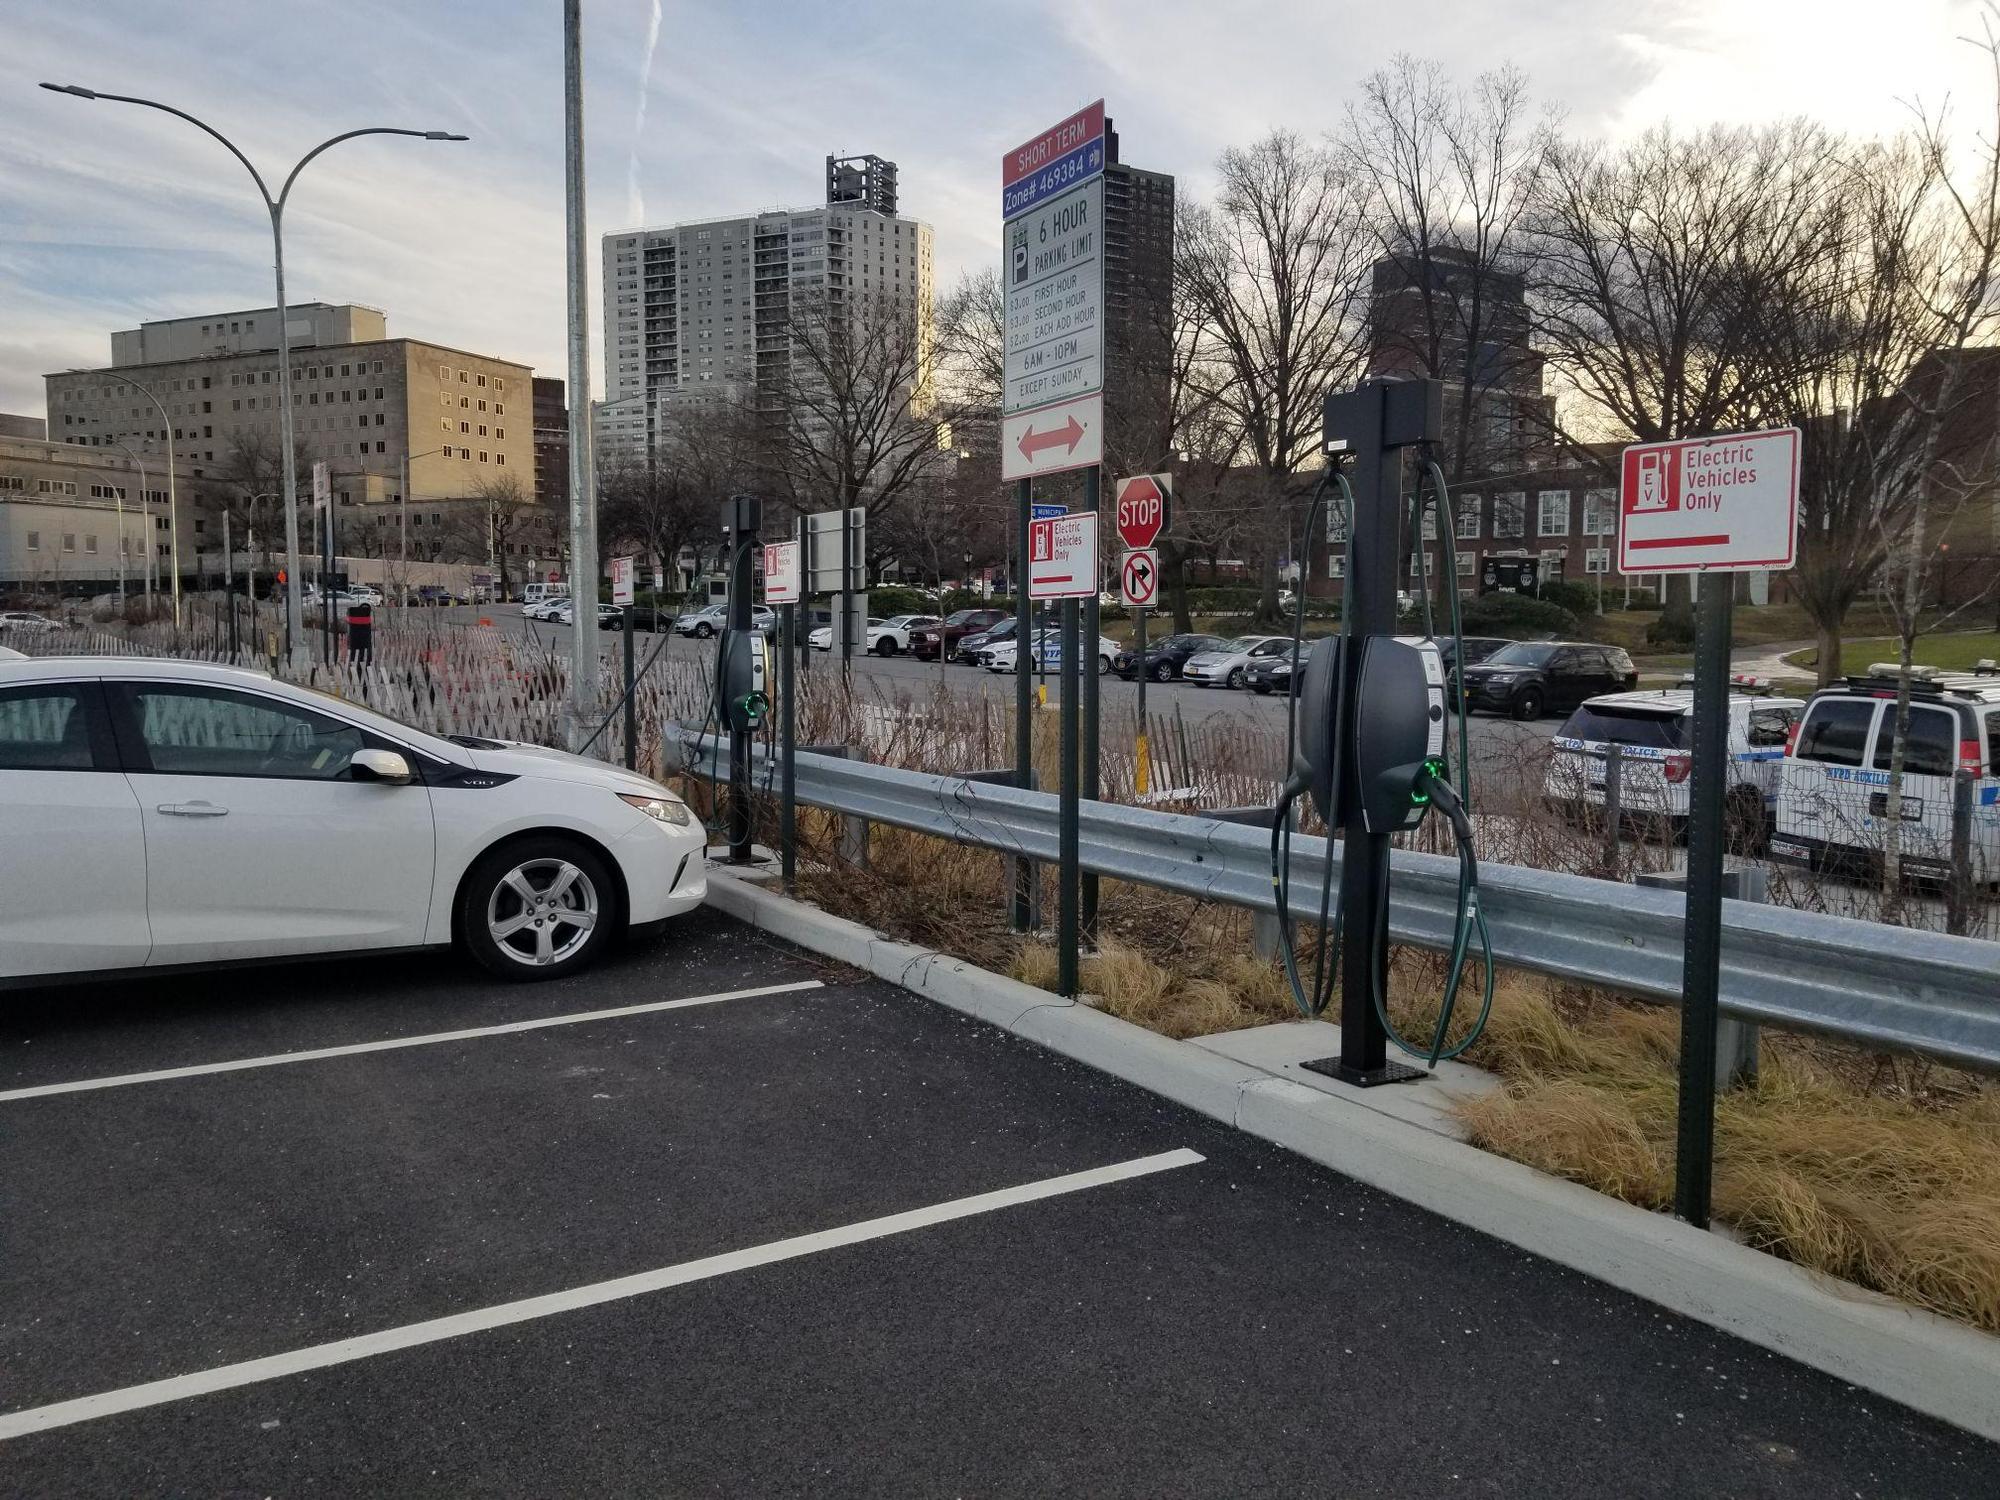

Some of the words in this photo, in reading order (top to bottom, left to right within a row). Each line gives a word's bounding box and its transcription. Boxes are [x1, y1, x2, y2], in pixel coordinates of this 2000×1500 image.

[1018, 137, 1052, 172] SHORT
[1055, 118, 1086, 152] TERM
[1005, 178, 1037, 212] Zone#
[1039, 155, 1084, 193] 469384
[1039, 220, 1047, 244] 6
[1053, 200, 1087, 238] HOUR
[1035, 244, 1067, 274] PARKING
[1071, 232, 1093, 259] LIMIT
[1034, 283, 1054, 302] FIRST
[1056, 274, 1077, 294] HOUR
[1034, 300, 1063, 320] SECOND
[1065, 290, 1086, 309] HOUR
[1034, 321, 1054, 338] EACH
[1056, 315, 1072, 331] ADD
[1074, 306, 1095, 325] HOUR
[1024, 352, 1043, 370] 6AM
[1054, 339, 1078, 361] 10PM
[1020, 376, 1047, 397] EXCEPT
[1051, 367, 1083, 388] SUNDAY
[1687, 444, 1754, 468] Electric
[1687, 467, 1757, 489] Vehicles
[1120, 498, 1159, 527] STOP
[1686, 492, 1722, 512] Only
[1055, 521, 1081, 535] Electric
[1055, 535, 1082, 547] Vehicles
[1055, 549, 1069, 562] Only
